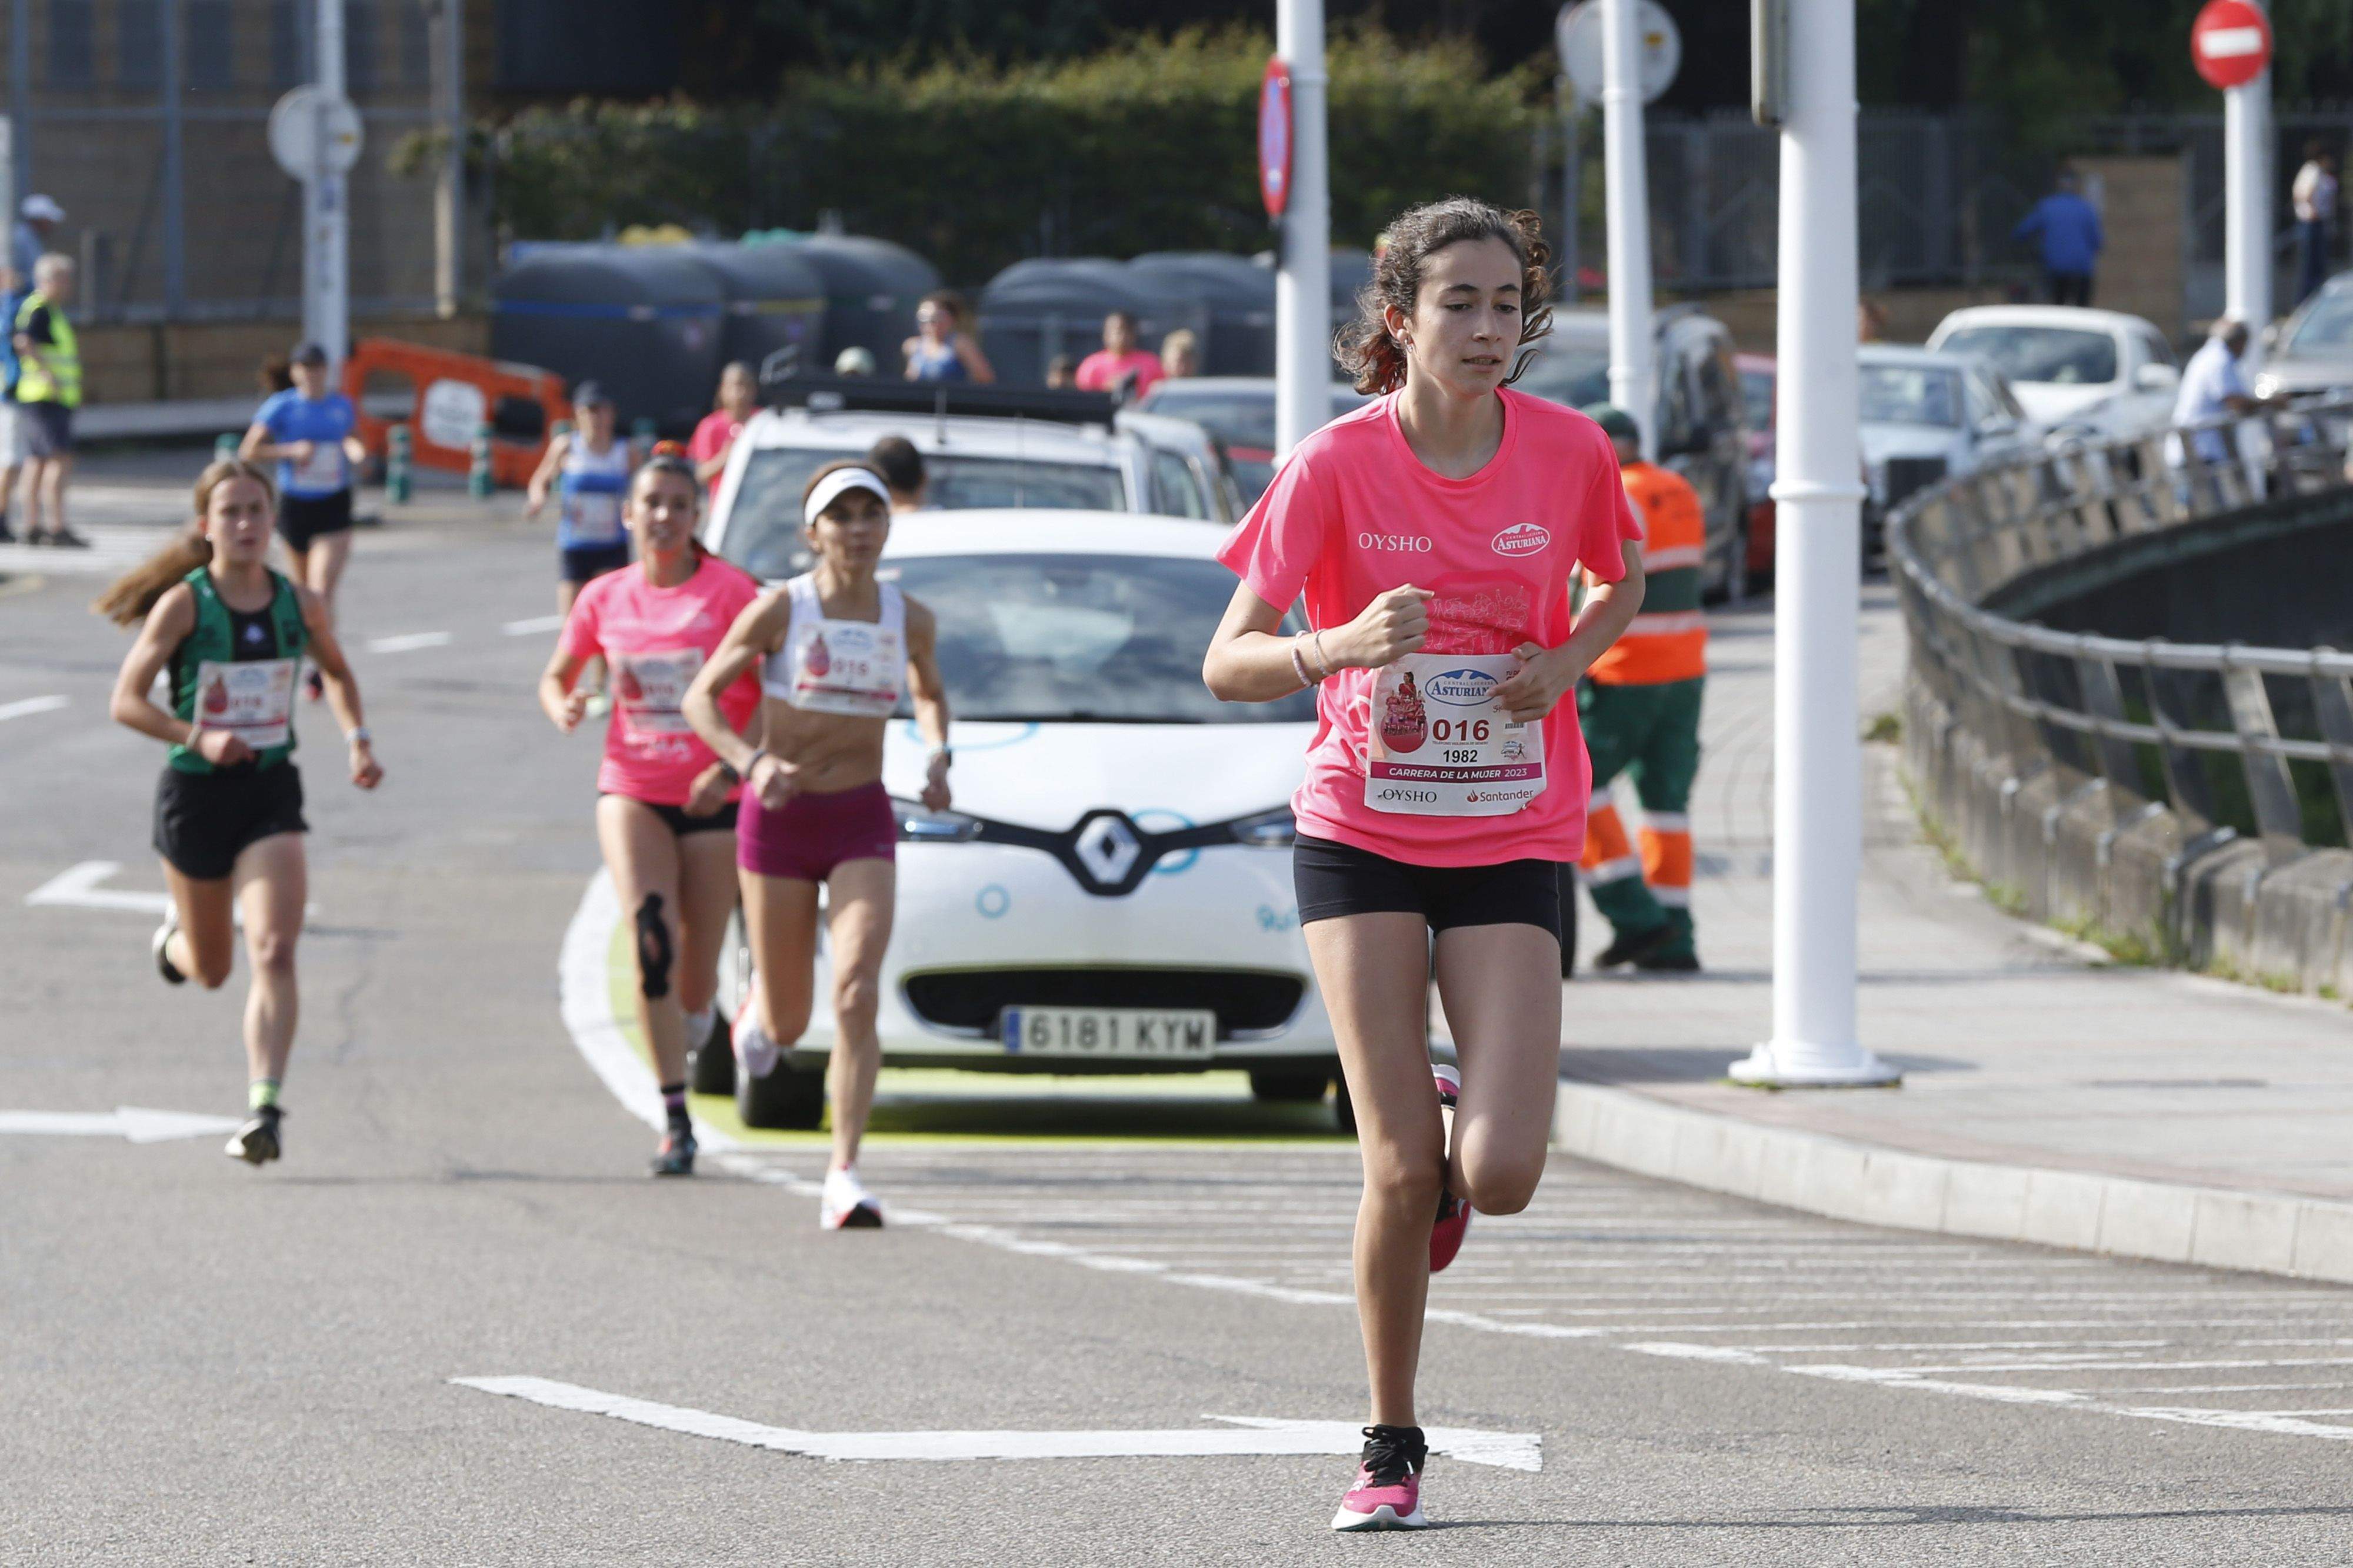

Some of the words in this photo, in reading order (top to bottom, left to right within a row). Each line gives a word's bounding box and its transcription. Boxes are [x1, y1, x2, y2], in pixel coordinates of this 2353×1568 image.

[1358, 532, 1432, 552] OYSHO
[1498, 535, 1547, 550] ASTURIANA
[1431, 681, 1489, 696] ASTURIAN
[1432, 719, 1489, 741] 016
[1443, 749, 1478, 763] 1982
[1389, 768, 1438, 779] CARRERA
[1440, 770, 1455, 779] DE
[1457, 771, 1469, 779] LA
[1471, 769, 1501, 779] MUJER
[1504, 768, 1528, 777] 2023
[1383, 788, 1437, 803] OYSHO
[1479, 789, 1534, 802] Santander
[1029, 1013, 1120, 1049] 6181
